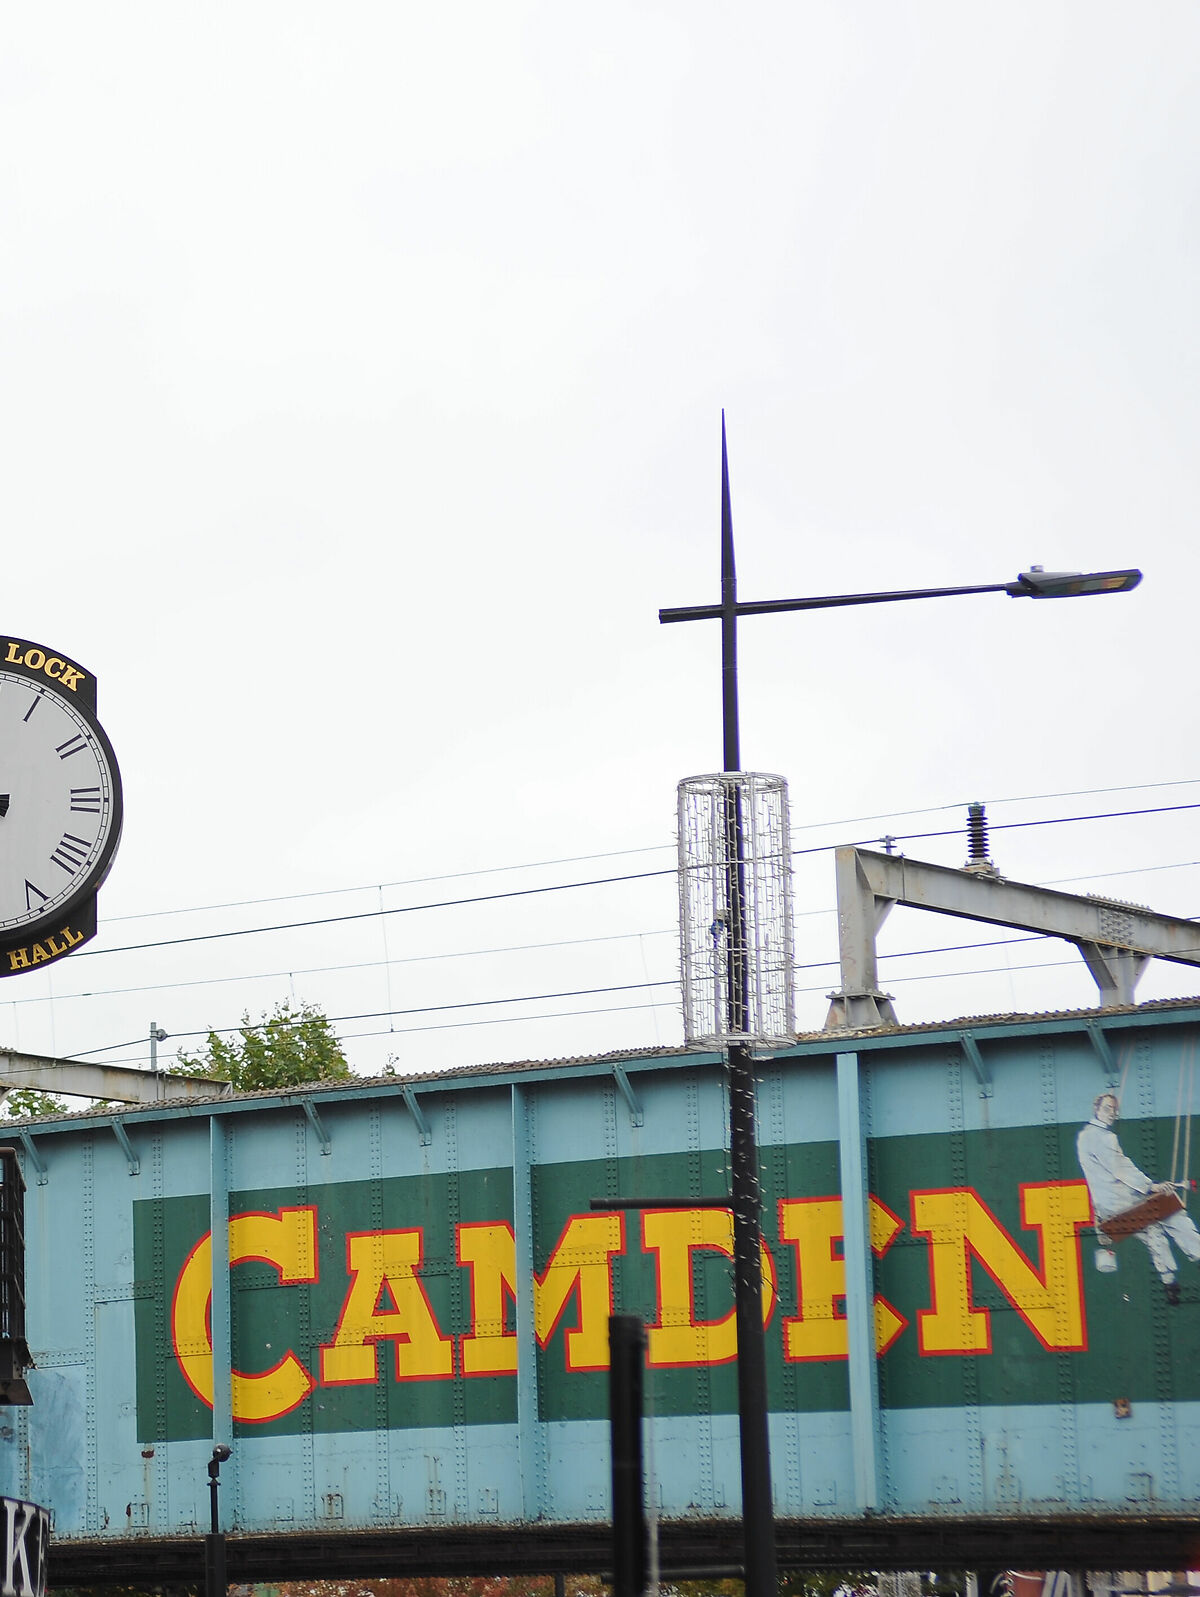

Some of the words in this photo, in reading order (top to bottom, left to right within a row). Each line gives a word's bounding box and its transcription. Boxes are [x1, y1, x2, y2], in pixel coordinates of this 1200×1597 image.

[5, 643, 86, 691] LOCK
[6, 926, 84, 970] HALL
[172, 1179, 1094, 1423] CAMDEN
